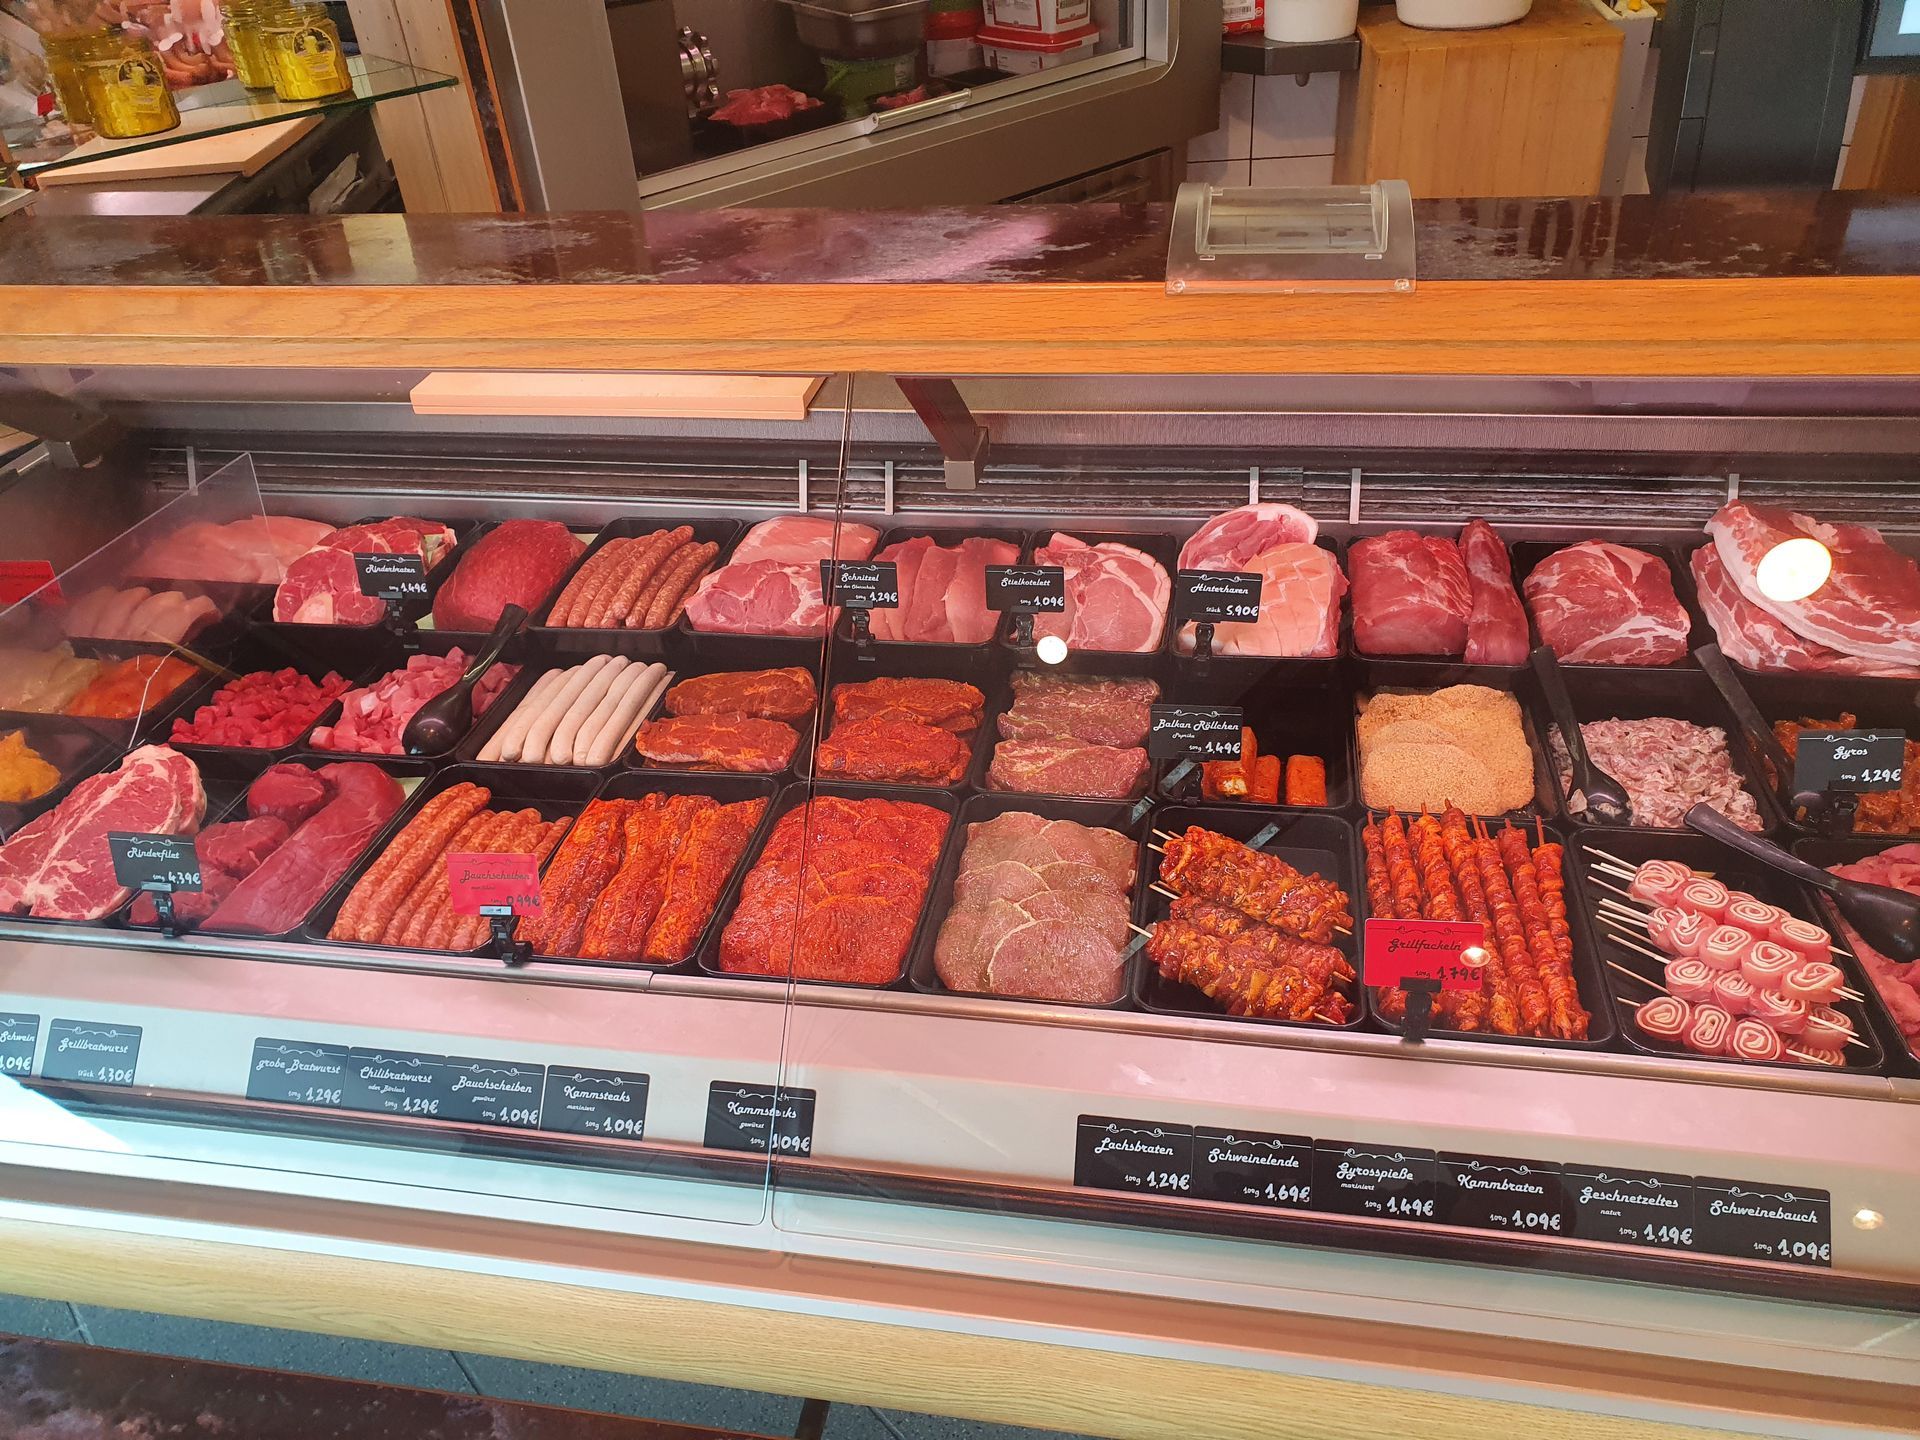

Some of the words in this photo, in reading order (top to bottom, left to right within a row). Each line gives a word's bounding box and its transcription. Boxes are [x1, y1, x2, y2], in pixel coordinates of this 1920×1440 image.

[365, 564, 416, 573] Rinderbraten
[841, 572, 880, 582] Schnitzel
[400, 582, 428, 593] 1,49€
[1000, 577, 1051, 587] Stielkotelett
[1190, 583, 1249, 594] Hinterhaxen
[869, 591, 898, 602] 1,29€
[1033, 595, 1064, 607] 1,09€
[1226, 604, 1259, 617] 5,90€
[1153, 719, 1191, 731] Balkan
[1193, 720, 1239, 731] Röllchen
[1205, 741, 1241, 754] 1,49€
[1833, 745, 1868, 760] Gyros
[1861, 768, 1902, 783] 1,29€
[127, 846, 180, 862] Rinderfilet
[168, 871, 201, 885] 4,39€
[460, 869, 529, 883] Bauchscheiben
[506, 895, 540, 907] 099€
[1388, 938, 1462, 953] Grillfackeln
[1436, 966, 1480, 981] 1,79€
[0, 1030, 36, 1043] Schwein
[58, 1037, 129, 1054] Grillbratwurst
[97, 1066, 134, 1083] 1,30€
[256, 1058, 286, 1071] grobe
[285, 1058, 341, 1074] Bratwurst
[360, 1066, 433, 1084] Chilibratwurst
[451, 1075, 533, 1094] Bauchscheiben
[305, 1086, 342, 1104] 1,29€
[563, 1085, 631, 1103] Kammsteaks
[402, 1096, 440, 1114] 1,29€
[500, 1106, 539, 1125] 1,09€
[603, 1116, 643, 1135] 1,09€
[772, 1133, 811, 1152] 109€
[1094, 1137, 1174, 1156] Lachsbraten
[1208, 1148, 1300, 1168] Schweinelende
[1146, 1170, 1190, 1190] 1,29€
[1336, 1162, 1414, 1182] Gyrosspieße
[1457, 1174, 1544, 1194] Kammbraten
[1264, 1183, 1311, 1203] 1,69€
[1579, 1186, 1679, 1208] Geschnetzeltes
[1386, 1196, 1434, 1217] 1,49€
[1600, 1209, 1621, 1217] natur
[1709, 1200, 1818, 1223] Schweinebauch
[1511, 1210, 1560, 1231] 1,09€
[1643, 1223, 1693, 1245] 1,19€
[1777, 1239, 1830, 1261] 1,09€
